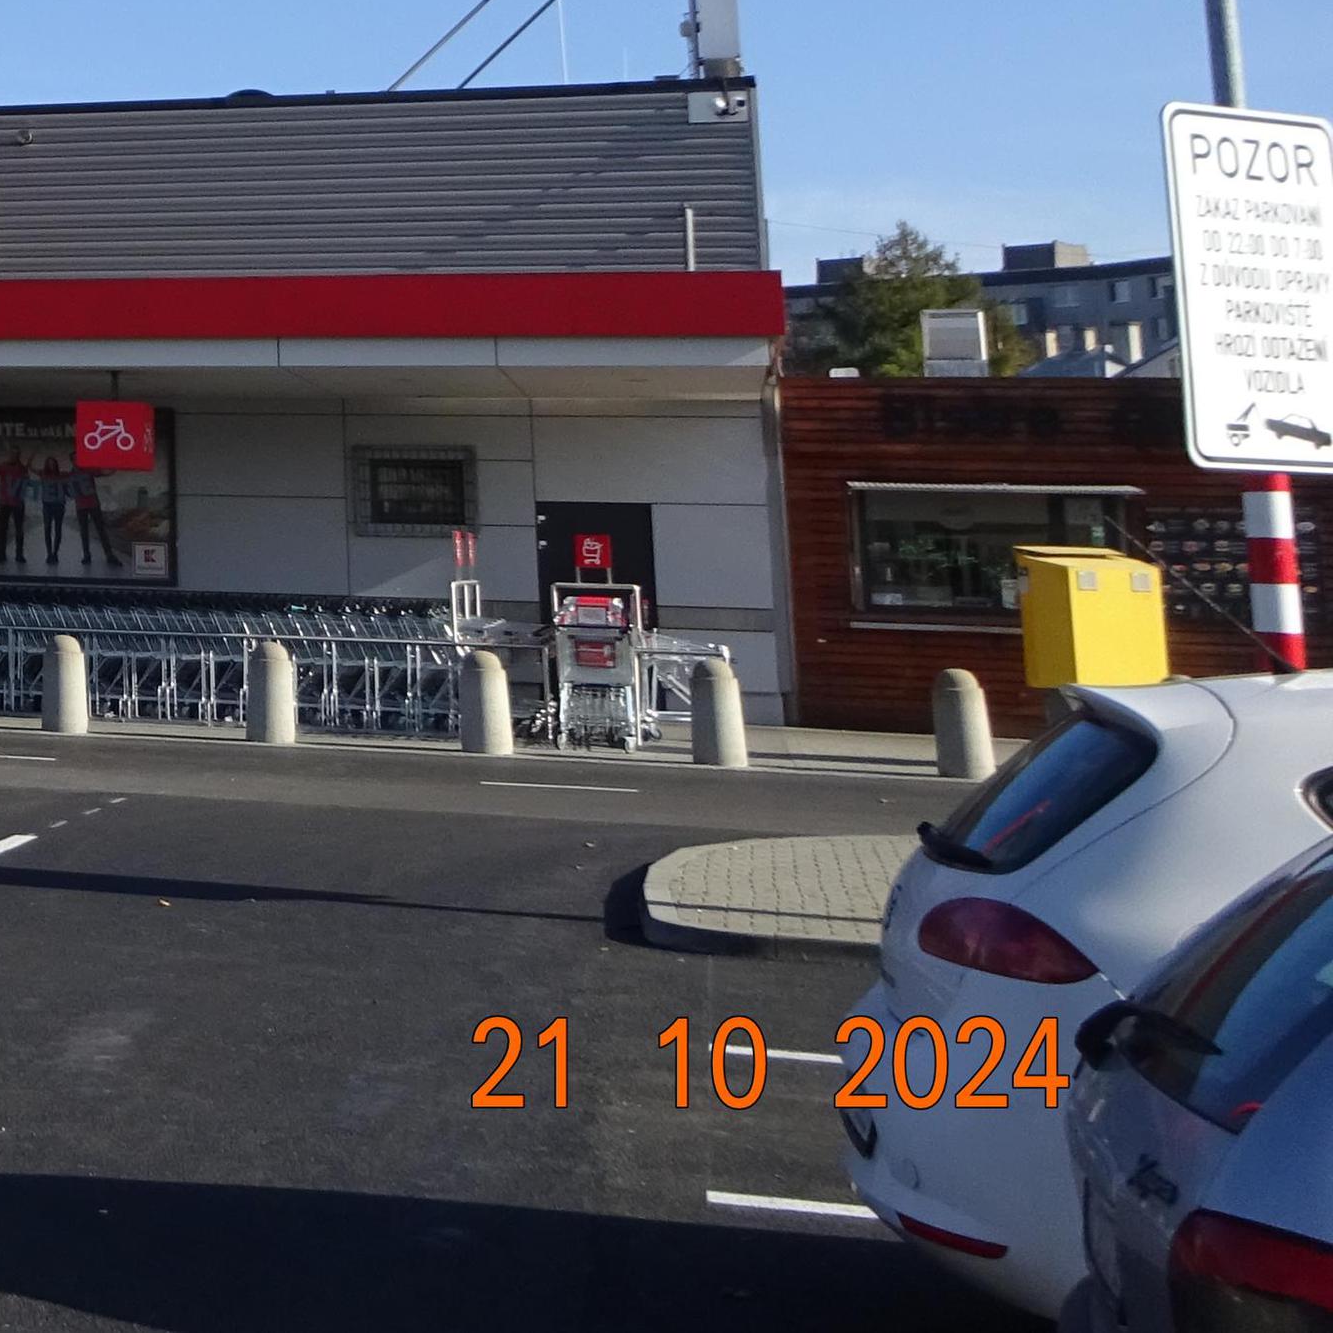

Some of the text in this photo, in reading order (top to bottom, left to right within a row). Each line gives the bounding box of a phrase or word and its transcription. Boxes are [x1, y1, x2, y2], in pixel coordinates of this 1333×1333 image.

[1190, 132, 1318, 187] POZOR
[1202, 229, 1222, 252] OD
[1270, 234, 1289, 258] DO
[1199, 258, 1330, 294] Z DŮVODU OPRAVY
[1244, 369, 1304, 394] VOZIDLA
